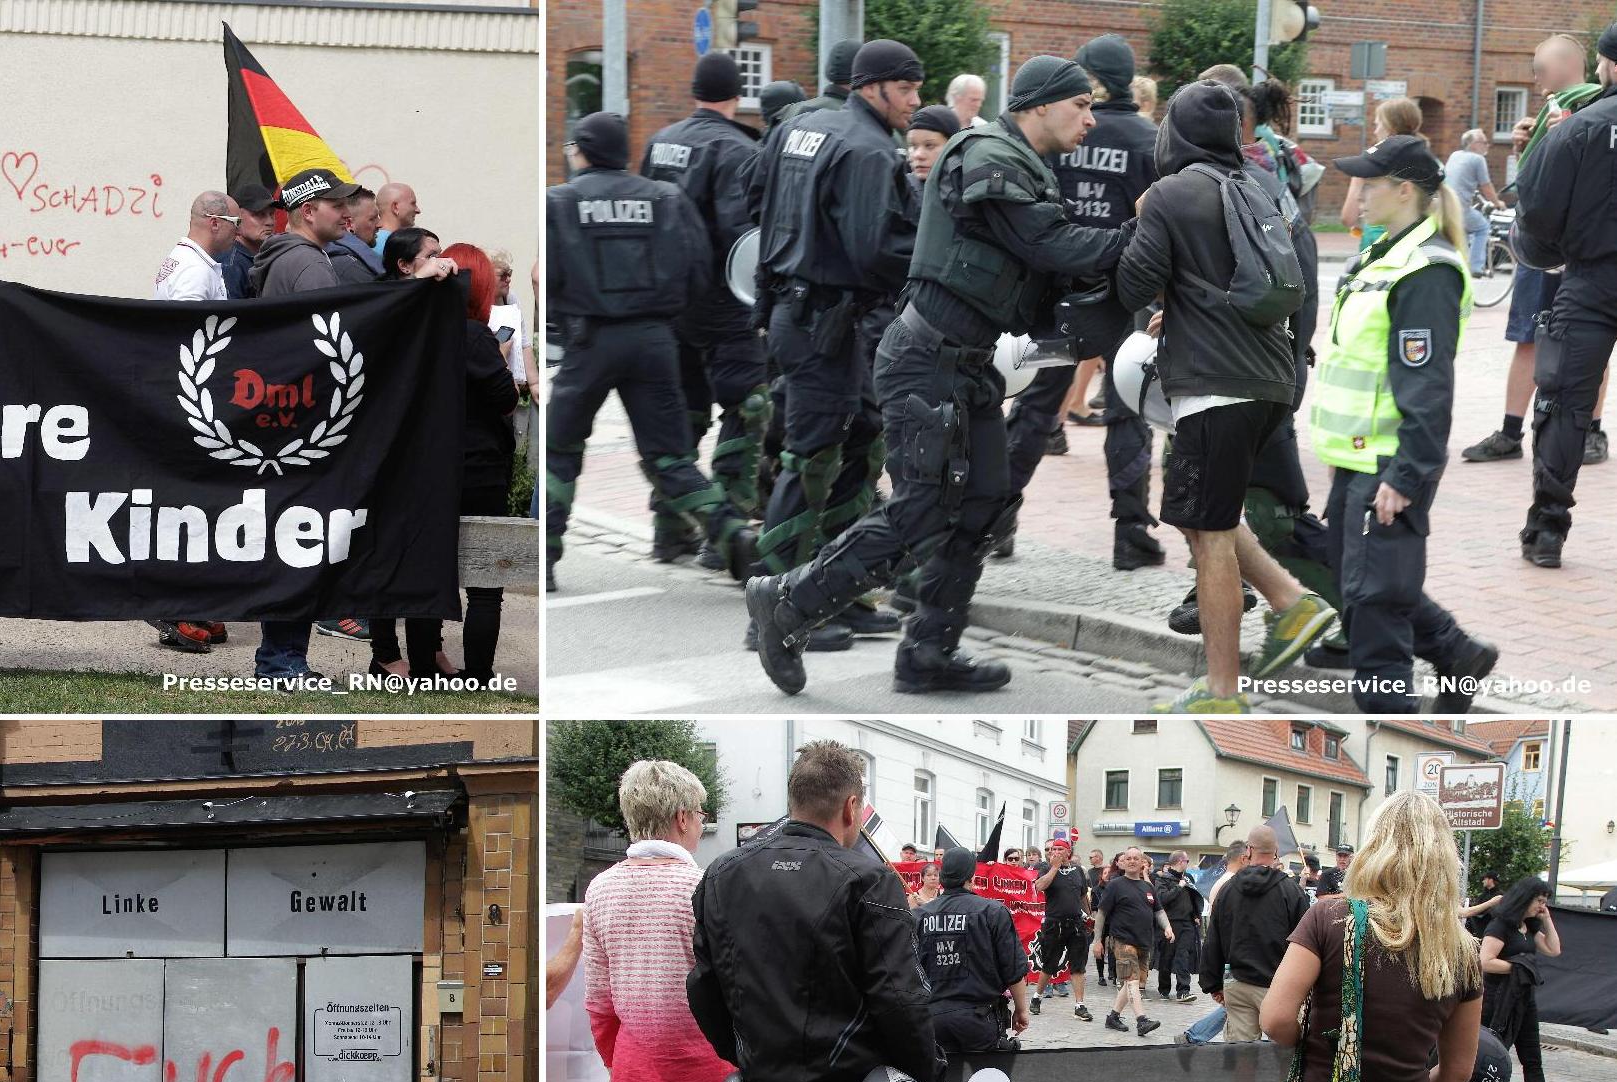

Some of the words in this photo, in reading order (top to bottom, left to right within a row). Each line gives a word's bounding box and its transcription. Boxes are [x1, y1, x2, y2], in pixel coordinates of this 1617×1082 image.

[783, 129, 826, 156] POLIZEI
[578, 200, 653, 223] POLIZEI
[1074, 200, 1111, 217] 3132
[64, 488, 368, 567] Kinder
[1444, 810, 1492, 819] Historische
[1452, 818, 1484, 826] Altstadt
[102, 894, 159, 915] Linke
[290, 891, 368, 912] Gewalt
[924, 915, 967, 933] POLIZEI
[936, 953, 960, 965] 3232
